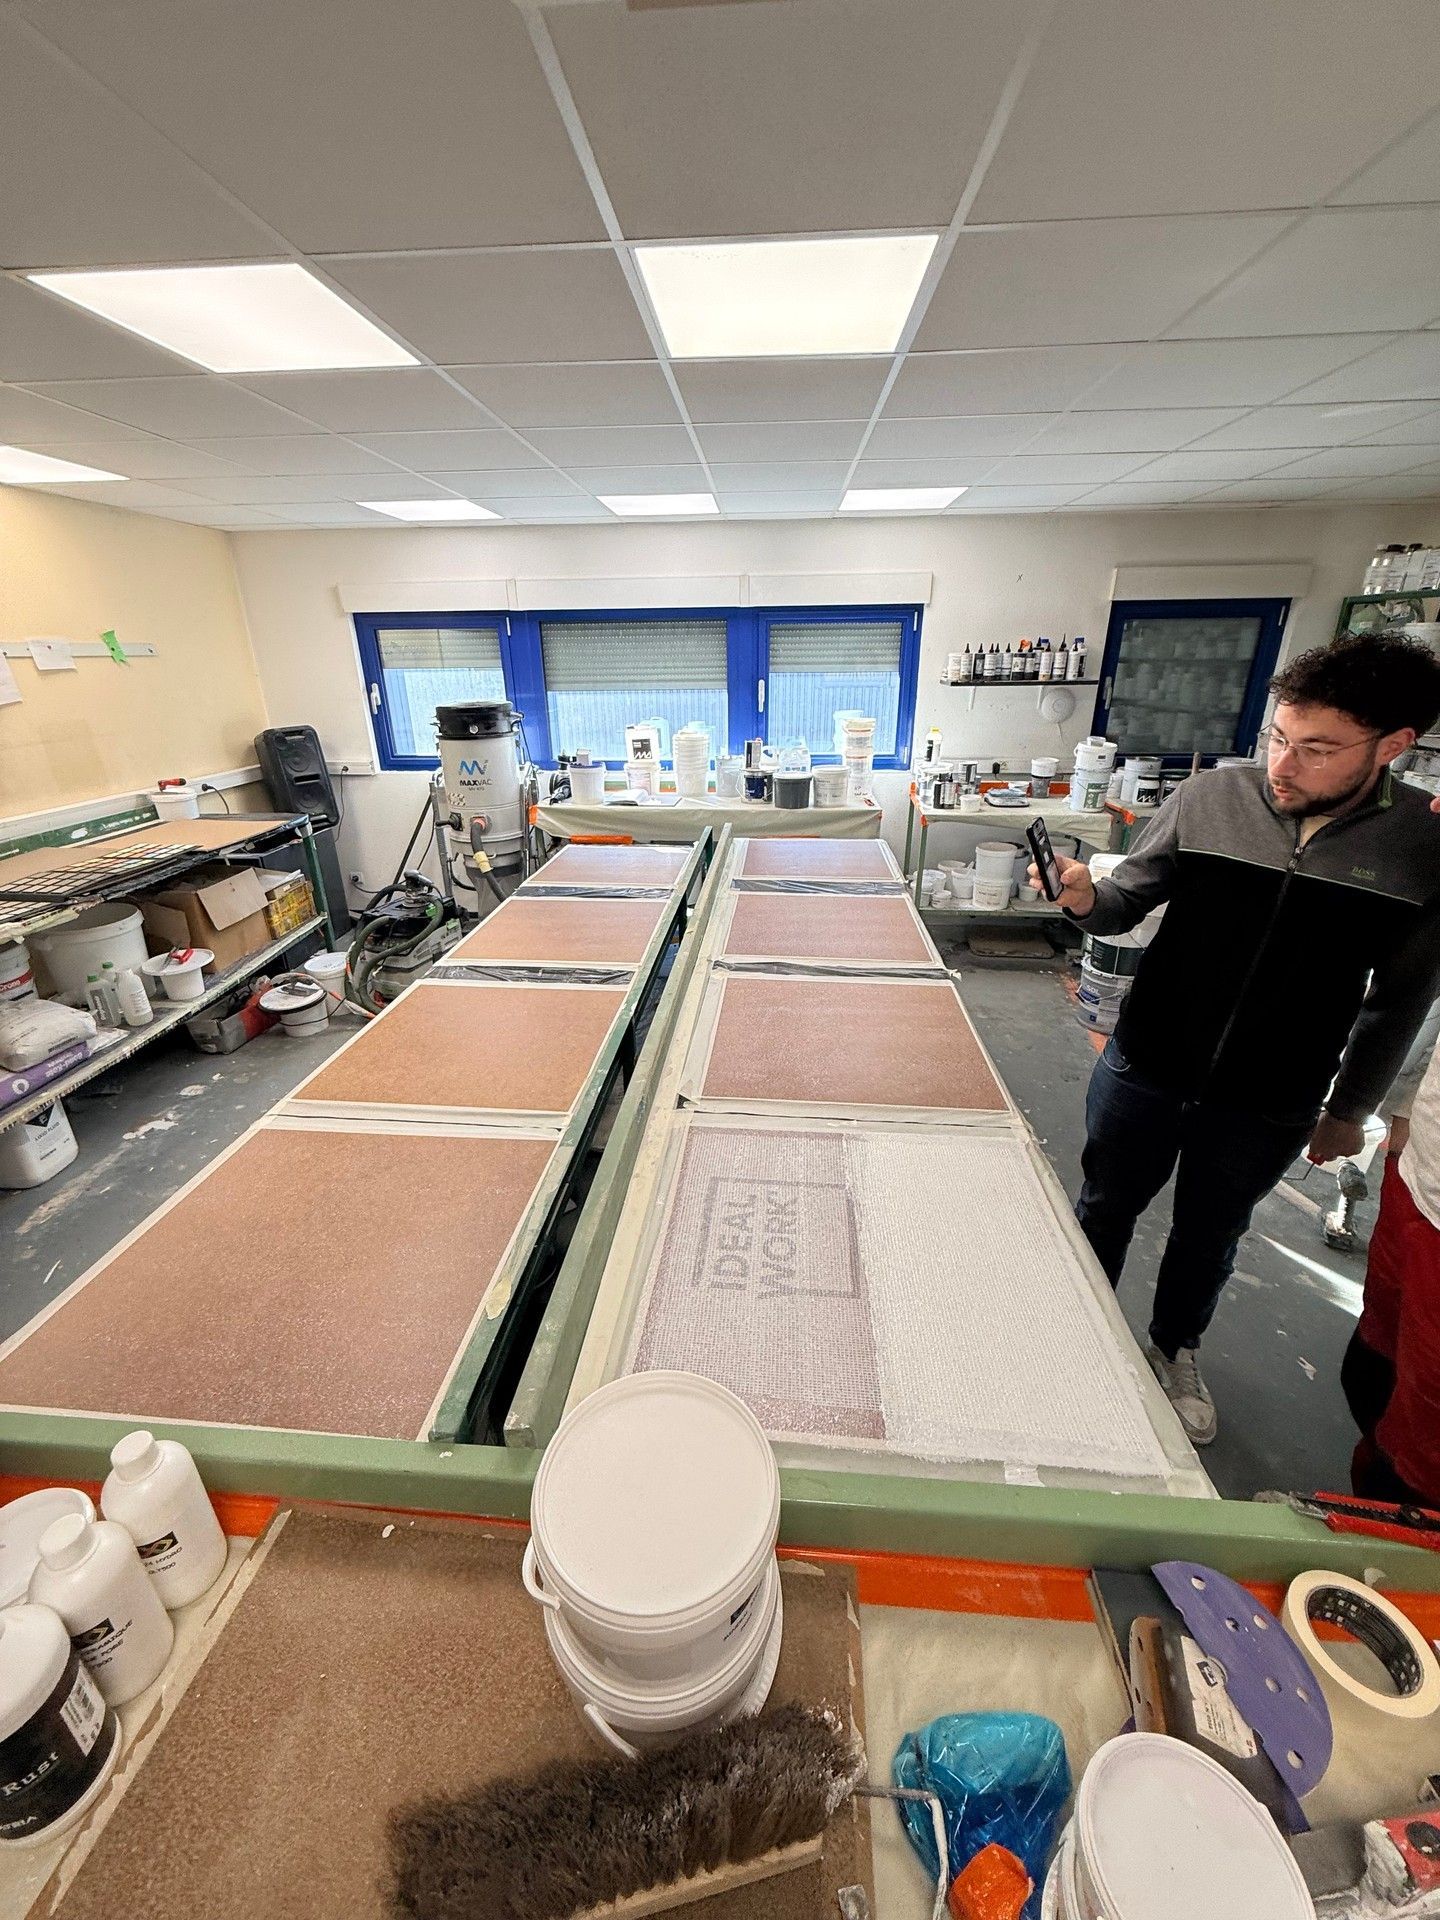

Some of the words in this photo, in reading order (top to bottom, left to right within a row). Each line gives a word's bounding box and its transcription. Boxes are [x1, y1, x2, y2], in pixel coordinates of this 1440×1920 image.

[710, 1194, 757, 1291] IDEAL
[755, 1186, 800, 1299] WORK
[1, 1751, 59, 1797] Rust
